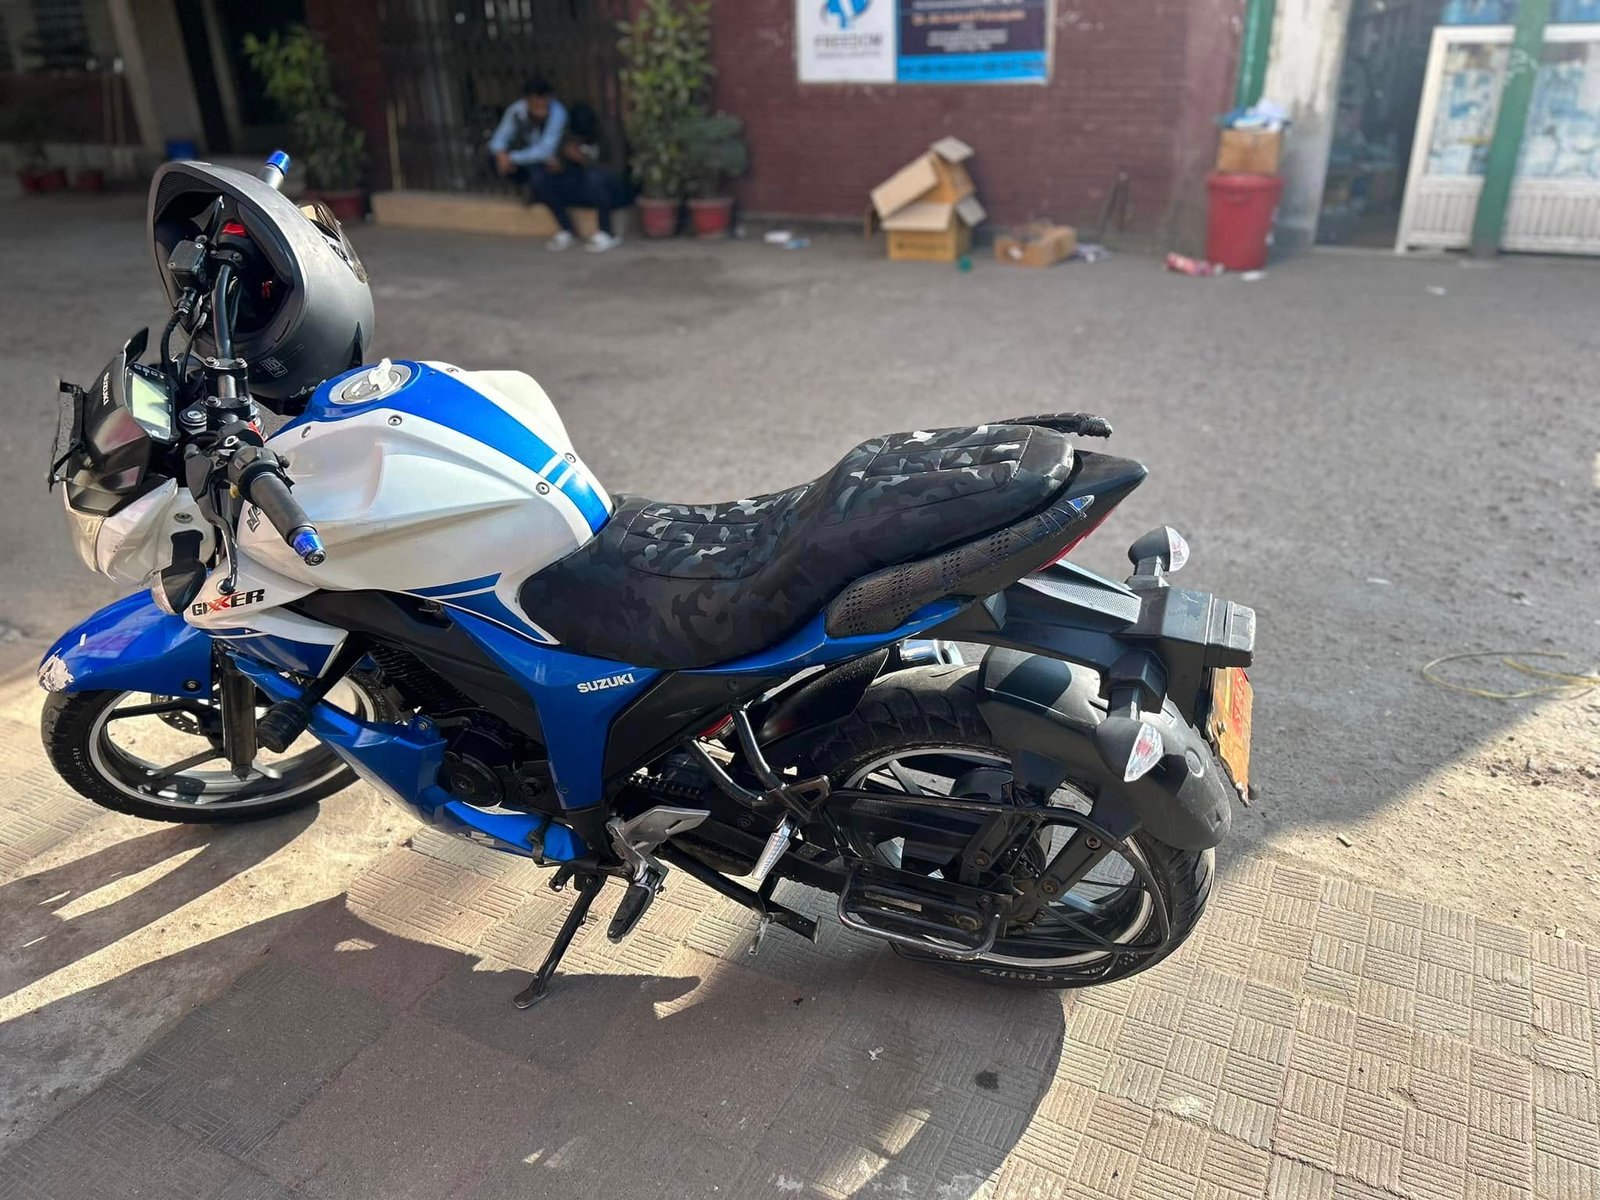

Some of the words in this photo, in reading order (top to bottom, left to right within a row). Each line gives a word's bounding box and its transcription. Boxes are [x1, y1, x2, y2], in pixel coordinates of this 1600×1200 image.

[102, 371, 110, 406] SUZUKI
[191, 588, 265, 617] GIXXER
[577, 672, 635, 694] SUZUKI
